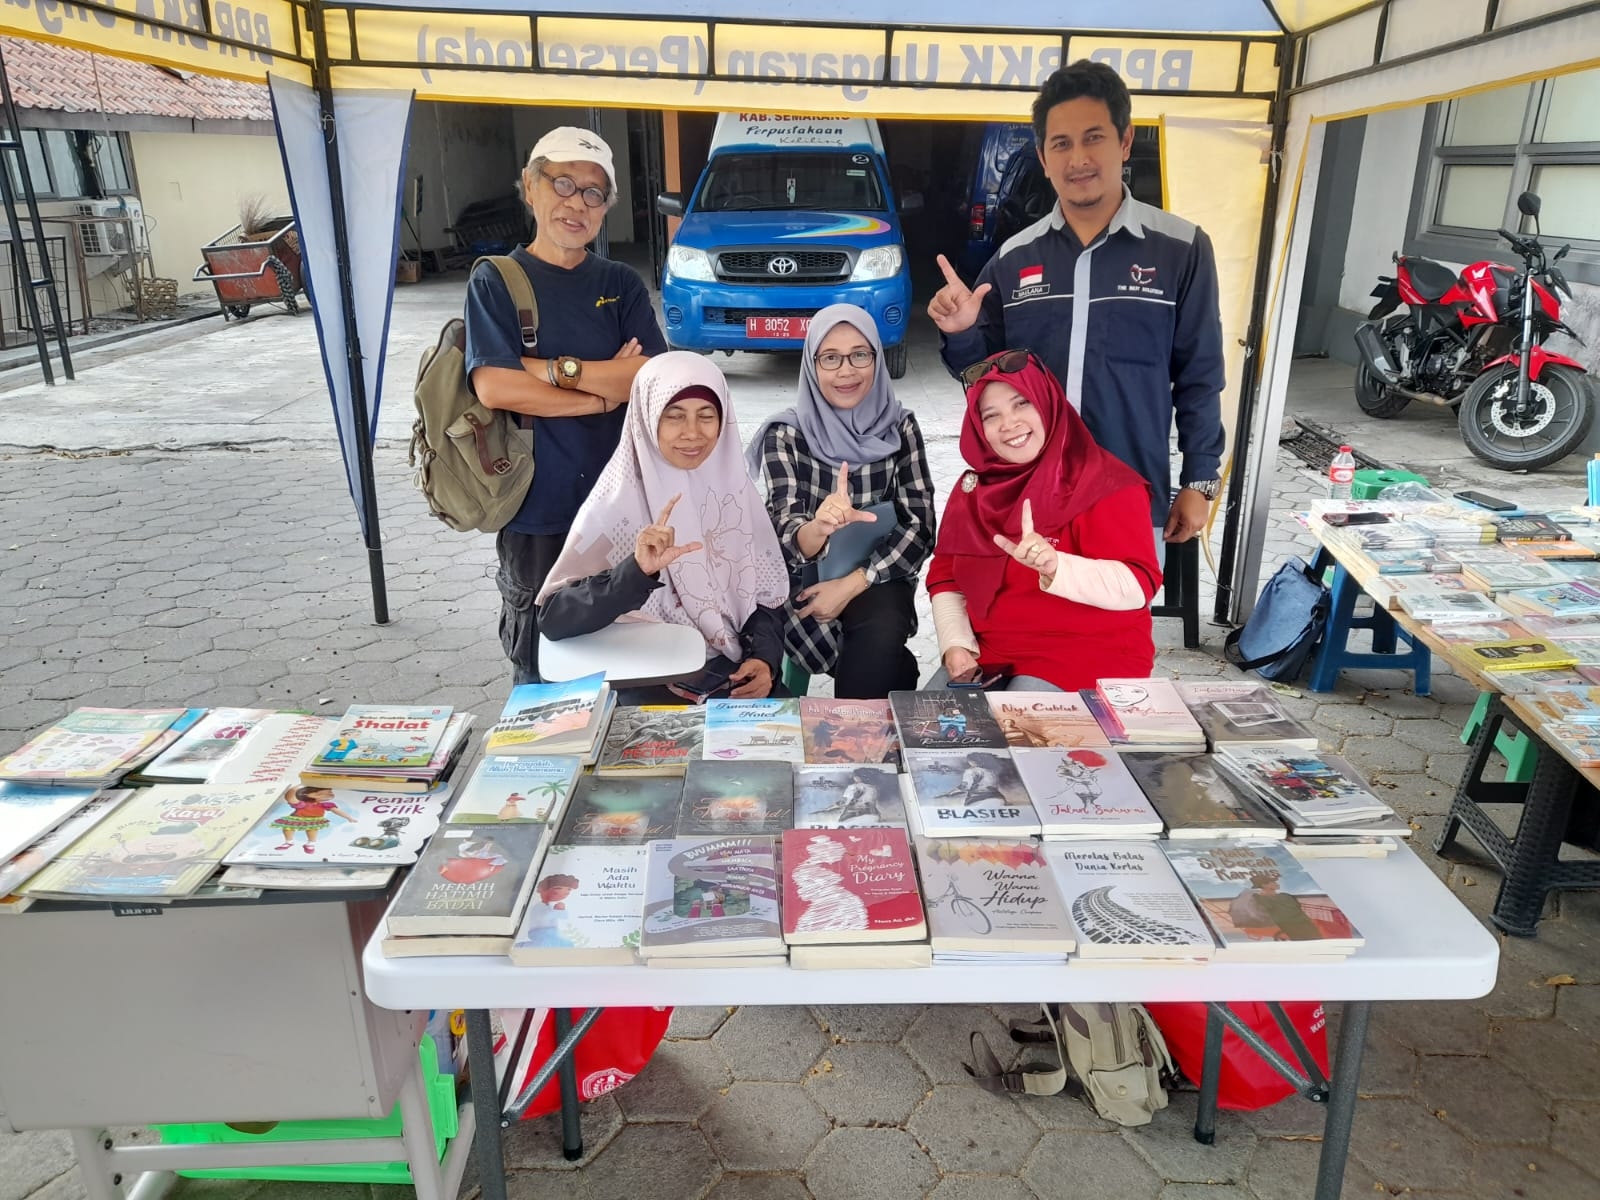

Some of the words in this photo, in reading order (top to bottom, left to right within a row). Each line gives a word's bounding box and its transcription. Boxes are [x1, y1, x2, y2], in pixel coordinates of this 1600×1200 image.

[746, 125, 843, 137] Perpustakaan
[855, 155, 866, 164] 2
[750, 319, 757, 331] H
[352, 719, 431, 729] Shalat
[361, 794, 432, 804] Penari
[372, 804, 425, 815] Cilik
[936, 808, 1020, 819] BLASTER
[856, 855, 875, 864] My
[849, 861, 904, 872] Pregnancy
[1075, 862, 1107, 871] Dunia
[852, 871, 906, 884] Diary
[432, 883, 495, 891] MERAIH
[980, 891, 1048, 909] Hidup
